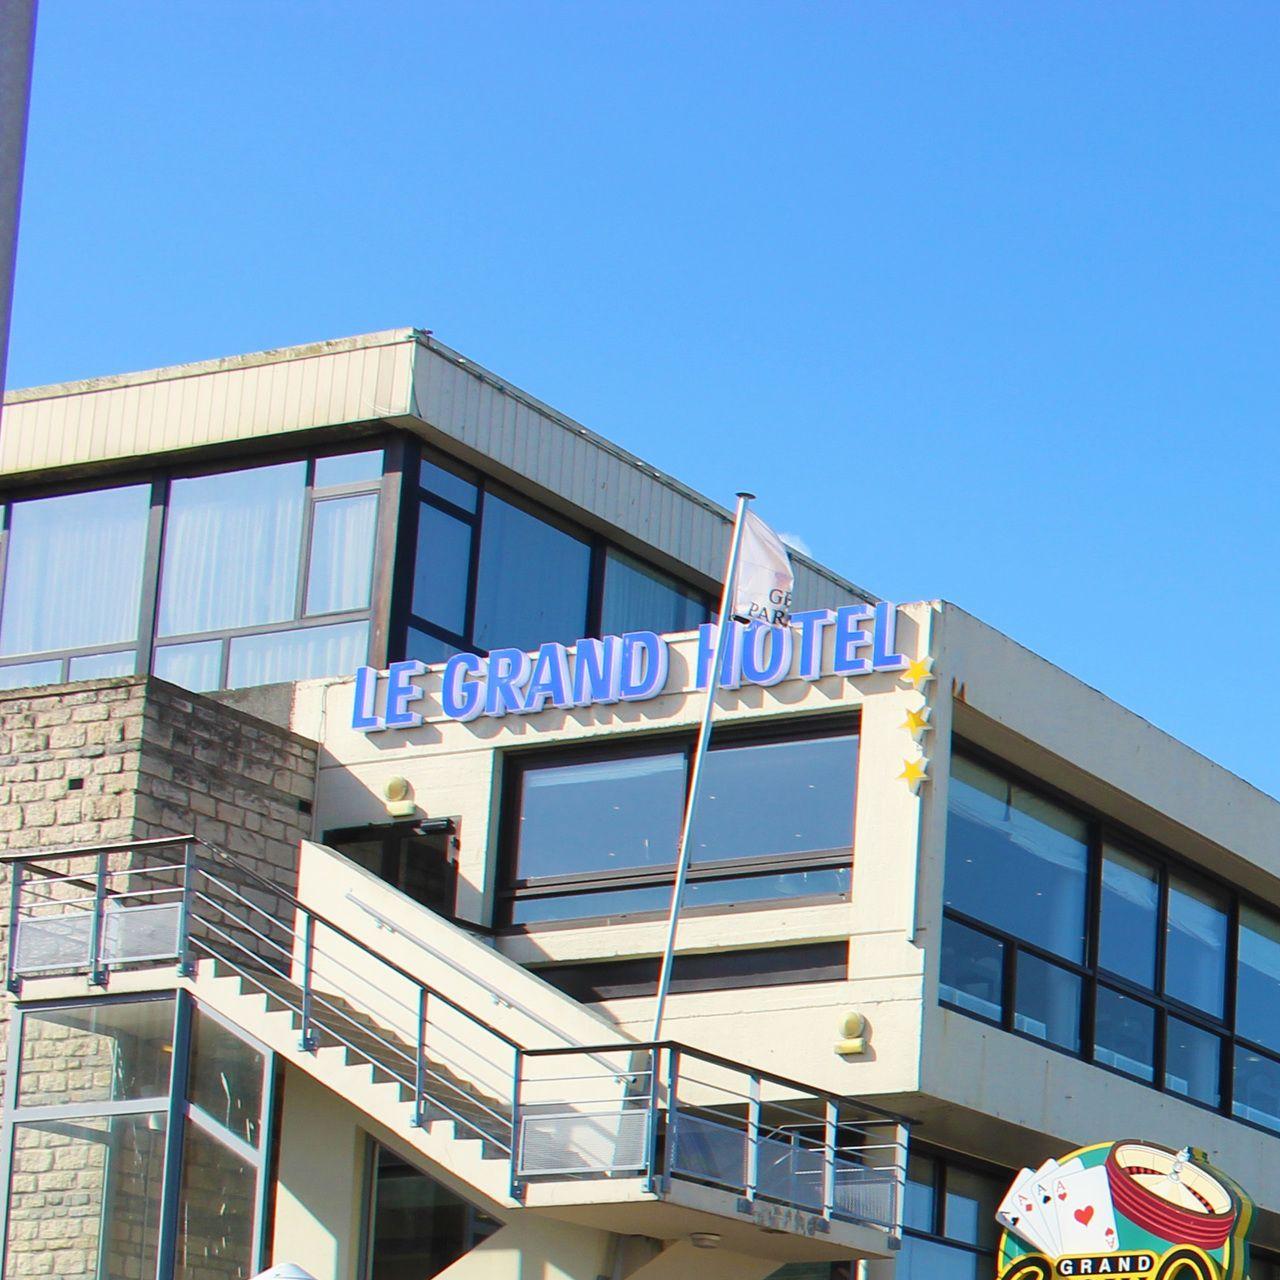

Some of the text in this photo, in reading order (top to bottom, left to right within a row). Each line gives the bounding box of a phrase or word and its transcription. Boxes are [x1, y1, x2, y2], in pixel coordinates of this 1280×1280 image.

[352, 601, 911, 733] LE GRAND HOTEL
[1060, 1255, 1153, 1275] GRAND
